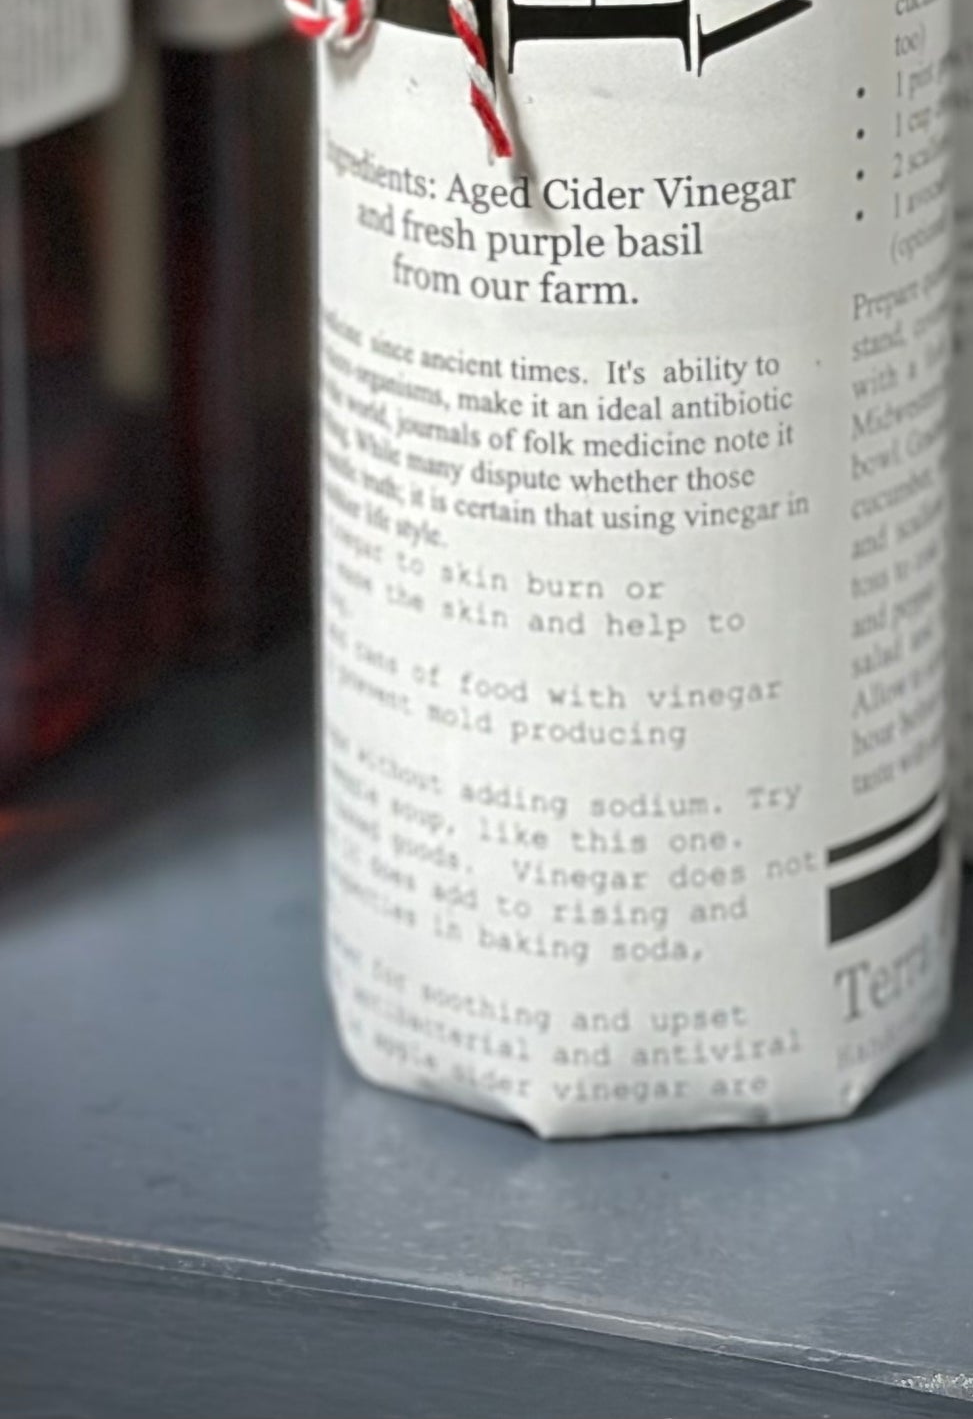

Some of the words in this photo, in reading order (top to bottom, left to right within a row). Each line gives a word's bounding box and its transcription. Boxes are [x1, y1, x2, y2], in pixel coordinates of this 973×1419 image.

[446, 175, 532, 214] Aged
[542, 177, 642, 210] Cider
[653, 175, 796, 212] Vinegar
[402, 209, 476, 251] fresh
[487, 224, 605, 265] purple
[614, 222, 702, 257] basil
[393, 252, 461, 296] from
[470, 277, 530, 302] our
[539, 271, 638, 304] farm.
[511, 360, 588, 384] times.
[608, 360, 645, 385] It's
[663, 356, 747, 386] ability
[755, 356, 779, 377] to
[532, 393, 548, 418] it
[557, 399, 588, 422] an
[598, 396, 662, 421] ideal
[671, 390, 792, 420] antibiotic
[488, 427, 518, 451] of
[523, 429, 574, 456] folk
[583, 431, 706, 458] medicine
[714, 429, 769, 454] note
[778, 424, 793, 447] it
[569, 469, 679, 493] whether
[686, 466, 754, 491] those
[544, 502, 594, 528] that
[602, 504, 675, 535] using
[683, 501, 780, 529] vinegar
[527, 571, 604, 600] burn
[625, 581, 664, 601] or
[528, 610, 585, 636] and
[604, 610, 686, 642] help
[708, 612, 744, 634] to
[548, 685, 626, 710] with
[646, 680, 781, 711] vinegar
[510, 719, 686, 750] producing
[589, 793, 722, 819] sodium.
[612, 936, 702, 962] soda,
